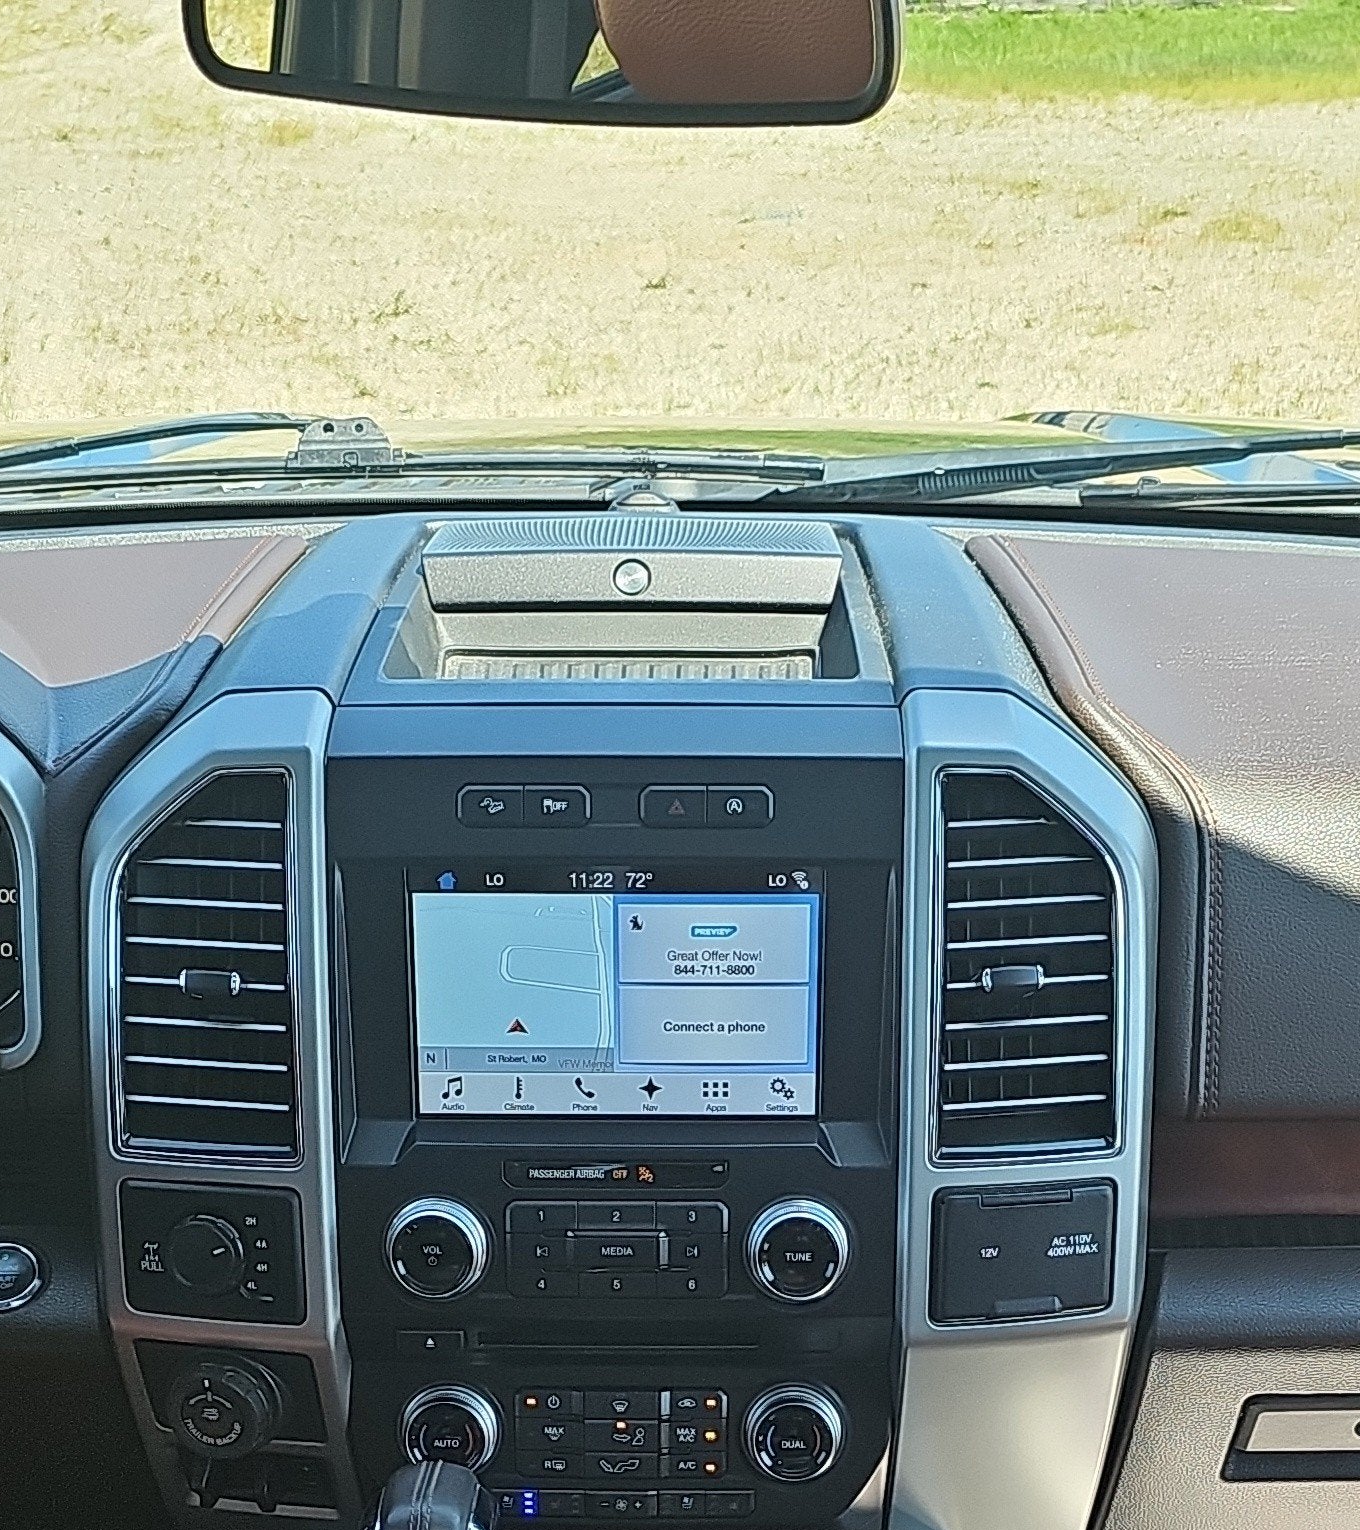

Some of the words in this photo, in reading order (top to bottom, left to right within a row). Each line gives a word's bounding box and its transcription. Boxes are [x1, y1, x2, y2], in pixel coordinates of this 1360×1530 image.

[486, 874, 504, 886] LO
[568, 873, 614, 888] 11:22
[768, 874, 787, 886] LO
[667, 950, 698, 961] Great
[701, 950, 729, 961] Offer
[732, 950, 762, 961] Now!
[674, 965, 755, 975] 844-711-8800
[663, 1021, 715, 1032] Connect
[719, 1024, 725, 1032] a
[727, 1021, 766, 1034] phone
[426, 1053, 436, 1063] N
[531, 1055, 547, 1063] MO
[442, 1103, 464, 1111] Audio
[504, 1103, 534, 1111] Climate
[572, 1103, 598, 1111] Phone
[643, 1104, 658, 1112] Nav
[706, 1104, 727, 1113] Apps
[765, 1104, 798, 1113] Settings
[529, 1169, 574, 1179] PASSENGER
[576, 1169, 605, 1179] AIRBAG
[539, 1211, 543, 1221] 1
[612, 1211, 620, 1221] 2
[688, 1211, 696, 1221] 3
[245, 1217, 256, 1226] 2H
[1051, 1236, 1067, 1246] AC
[1068, 1234, 1093, 1245] 110V
[422, 1246, 442, 1255] VOL
[601, 1246, 633, 1256] MEDIA
[980, 1248, 999, 1258] 12V
[1047, 1247, 1074, 1257] 400W
[1075, 1244, 1098, 1255] MAX
[785, 1252, 812, 1261] TUNE
[141, 1261, 164, 1272] PULL
[256, 1263, 268, 1272] 4H
[537, 1279, 545, 1289] 4
[613, 1279, 620, 1289] 5
[688, 1279, 696, 1289] 6
[184, 1418, 215, 1445] TRAILER
[544, 1426, 565, 1434] MAX
[676, 1428, 696, 1436] MAX
[433, 1439, 460, 1448] AUTO
[678, 1435, 695, 1443] A/C
[781, 1441, 807, 1449] DUAL
[544, 1461, 551, 1469] R
[677, 1462, 697, 1470] A/C
